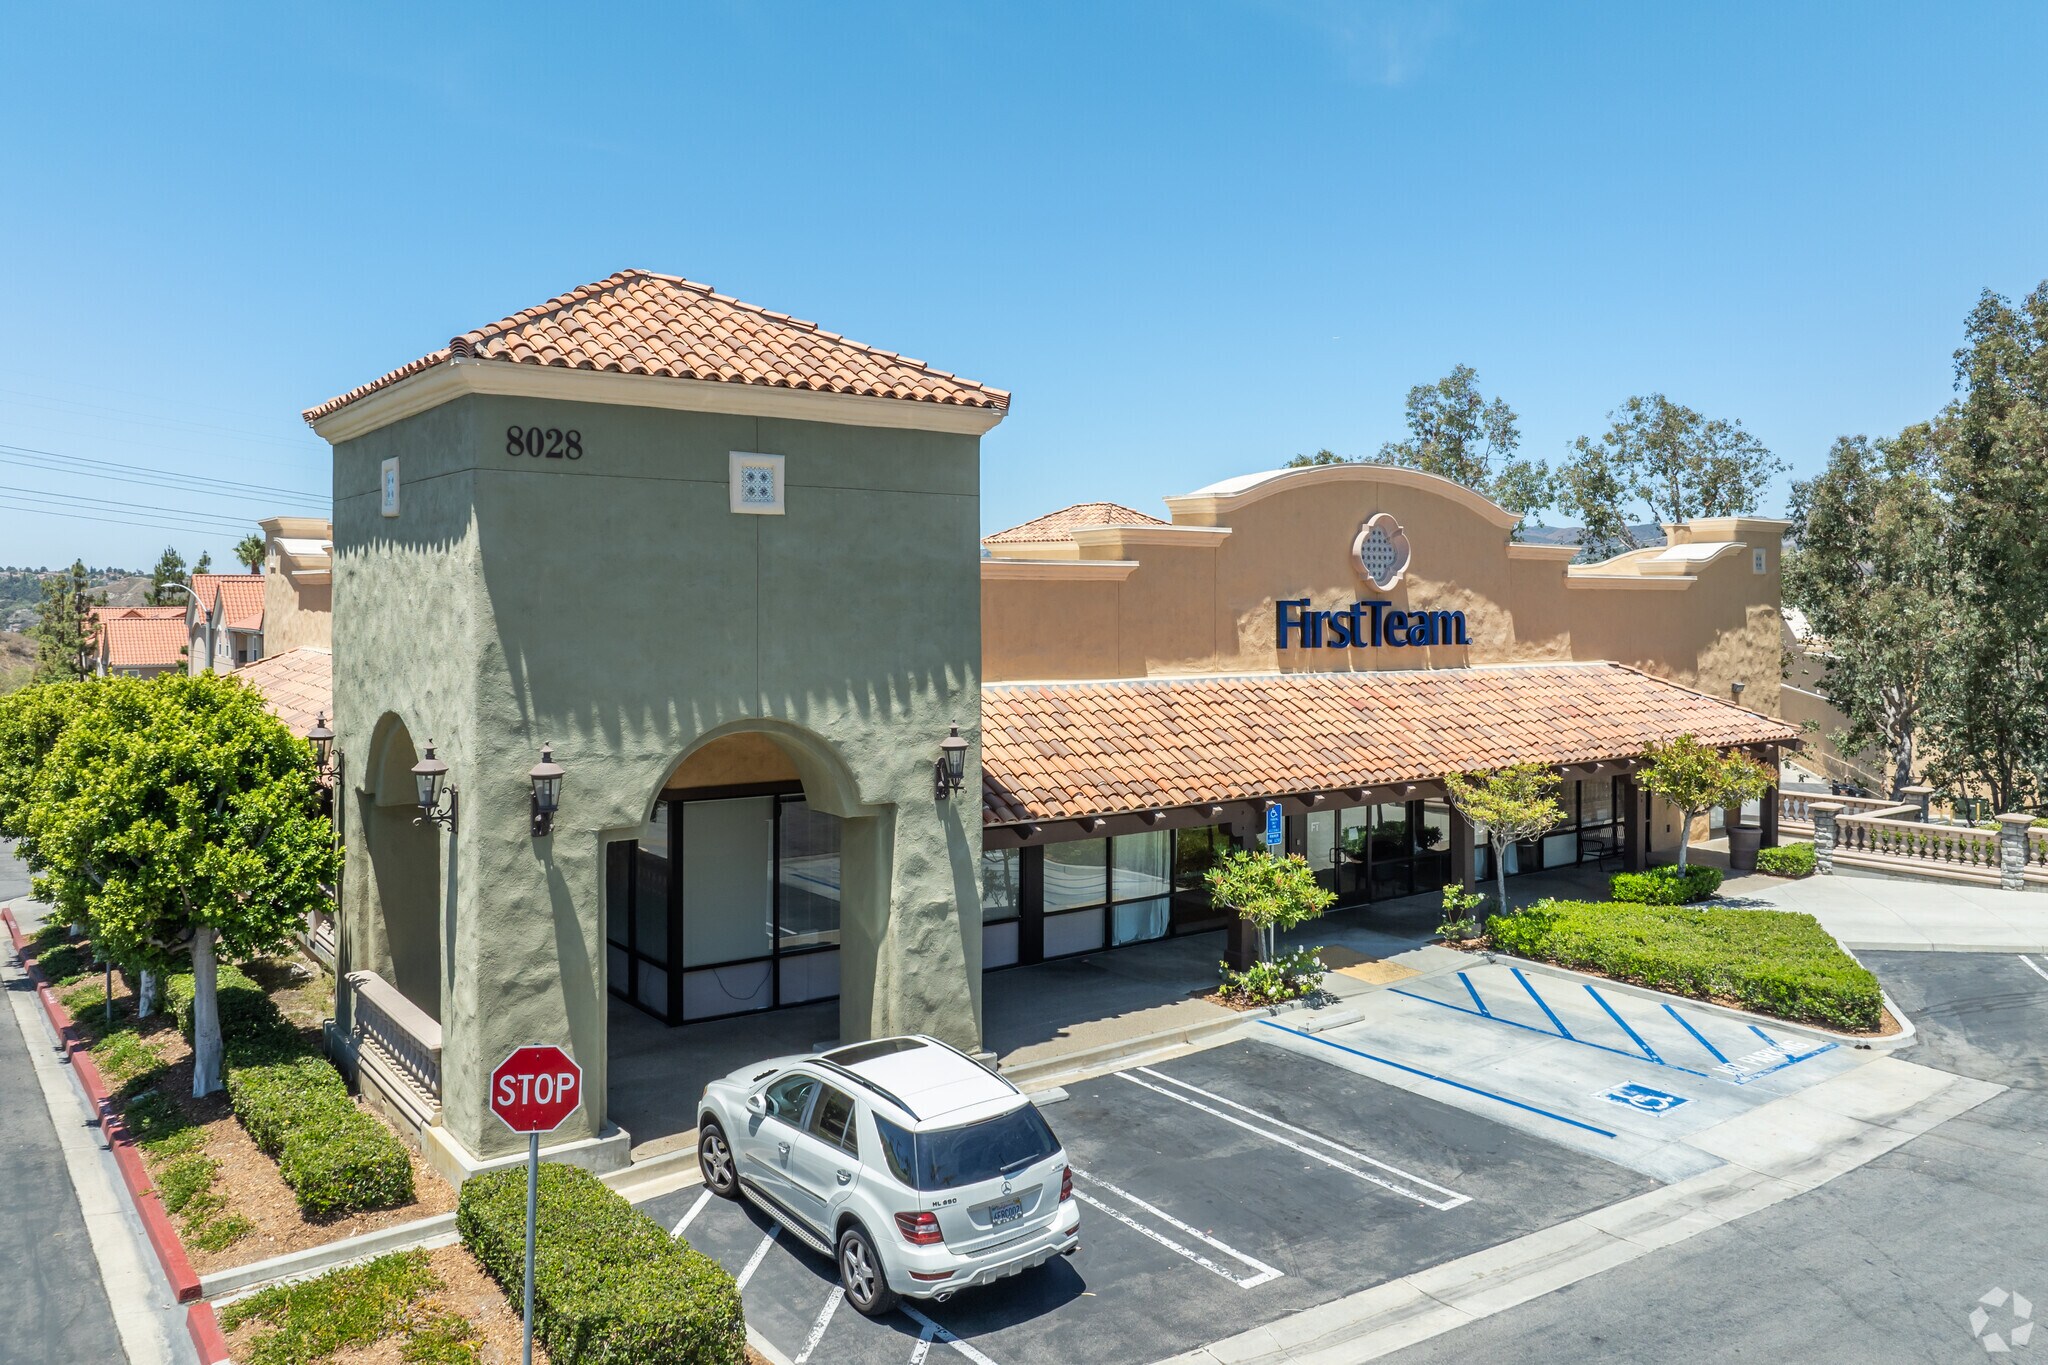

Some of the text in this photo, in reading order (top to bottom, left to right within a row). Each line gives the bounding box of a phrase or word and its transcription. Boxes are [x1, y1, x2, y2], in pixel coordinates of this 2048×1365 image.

[506, 425, 583, 460] 8028
[1737, 1040, 1811, 1067] PARKING
[497, 1073, 575, 1106] STOP
